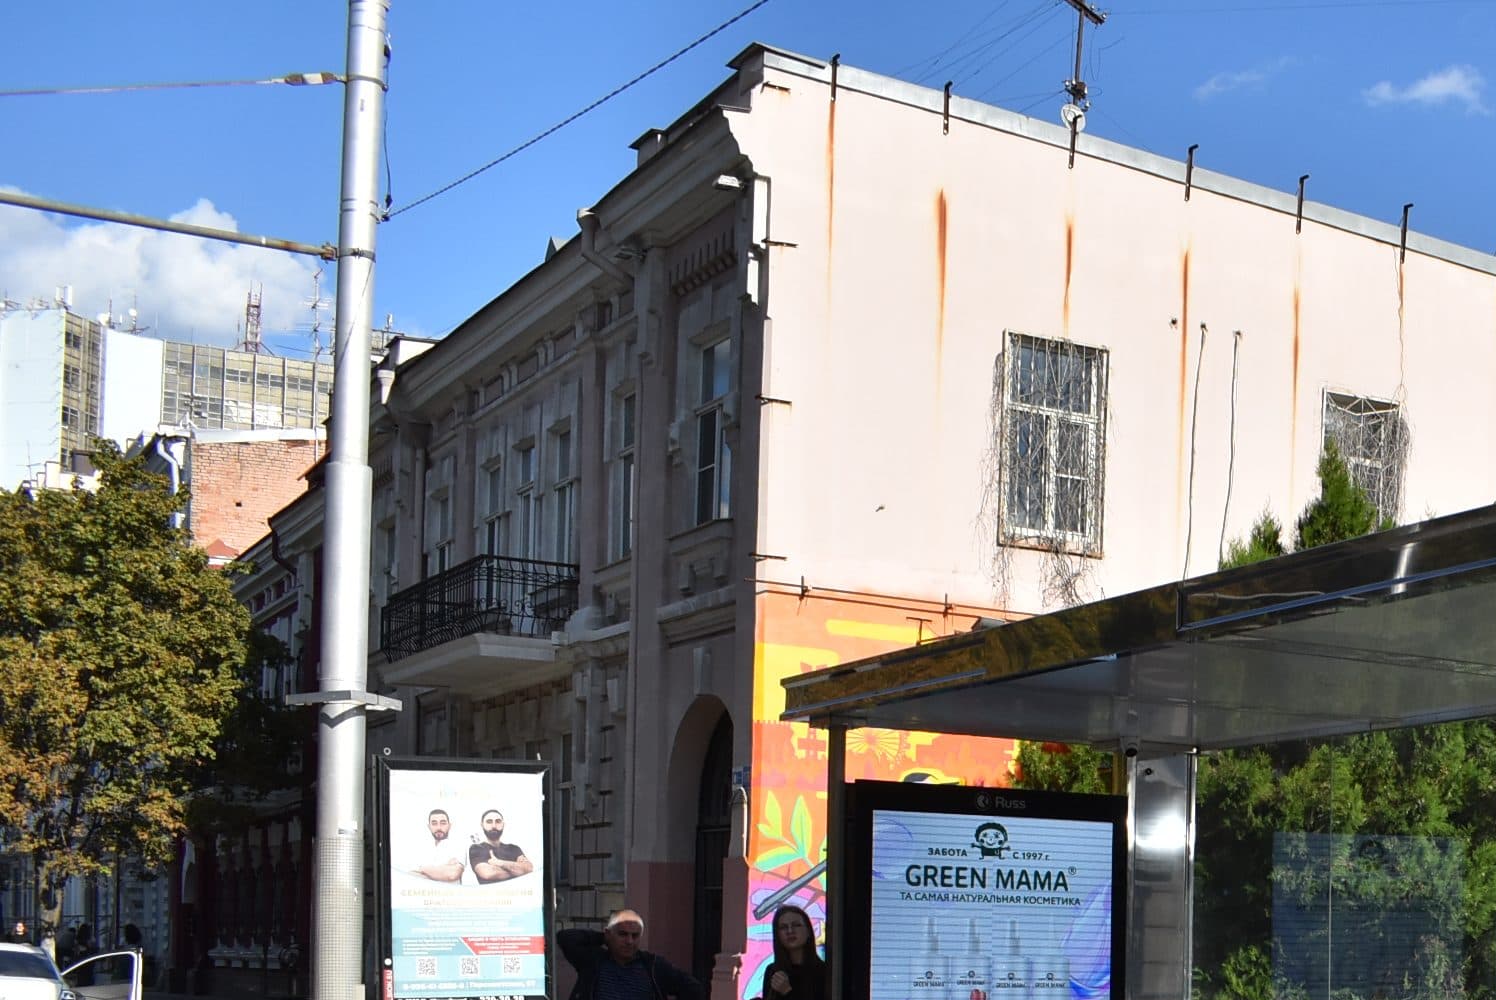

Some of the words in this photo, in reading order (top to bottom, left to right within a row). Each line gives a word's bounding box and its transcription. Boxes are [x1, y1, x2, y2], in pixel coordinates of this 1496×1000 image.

[996, 796, 1026, 809] Russ
[928, 848, 967, 857] ЗАБОТА
[1022, 852, 1043, 860] 1997
[906, 865, 986, 888] GREEN
[900, 891, 912, 900] ТА
[915, 892, 949, 901] САМАЯ
[952, 893, 1022, 904] НАТУРАЛЬНАЯ
[1023, 895, 1081, 906] КОСМЕТИКА
